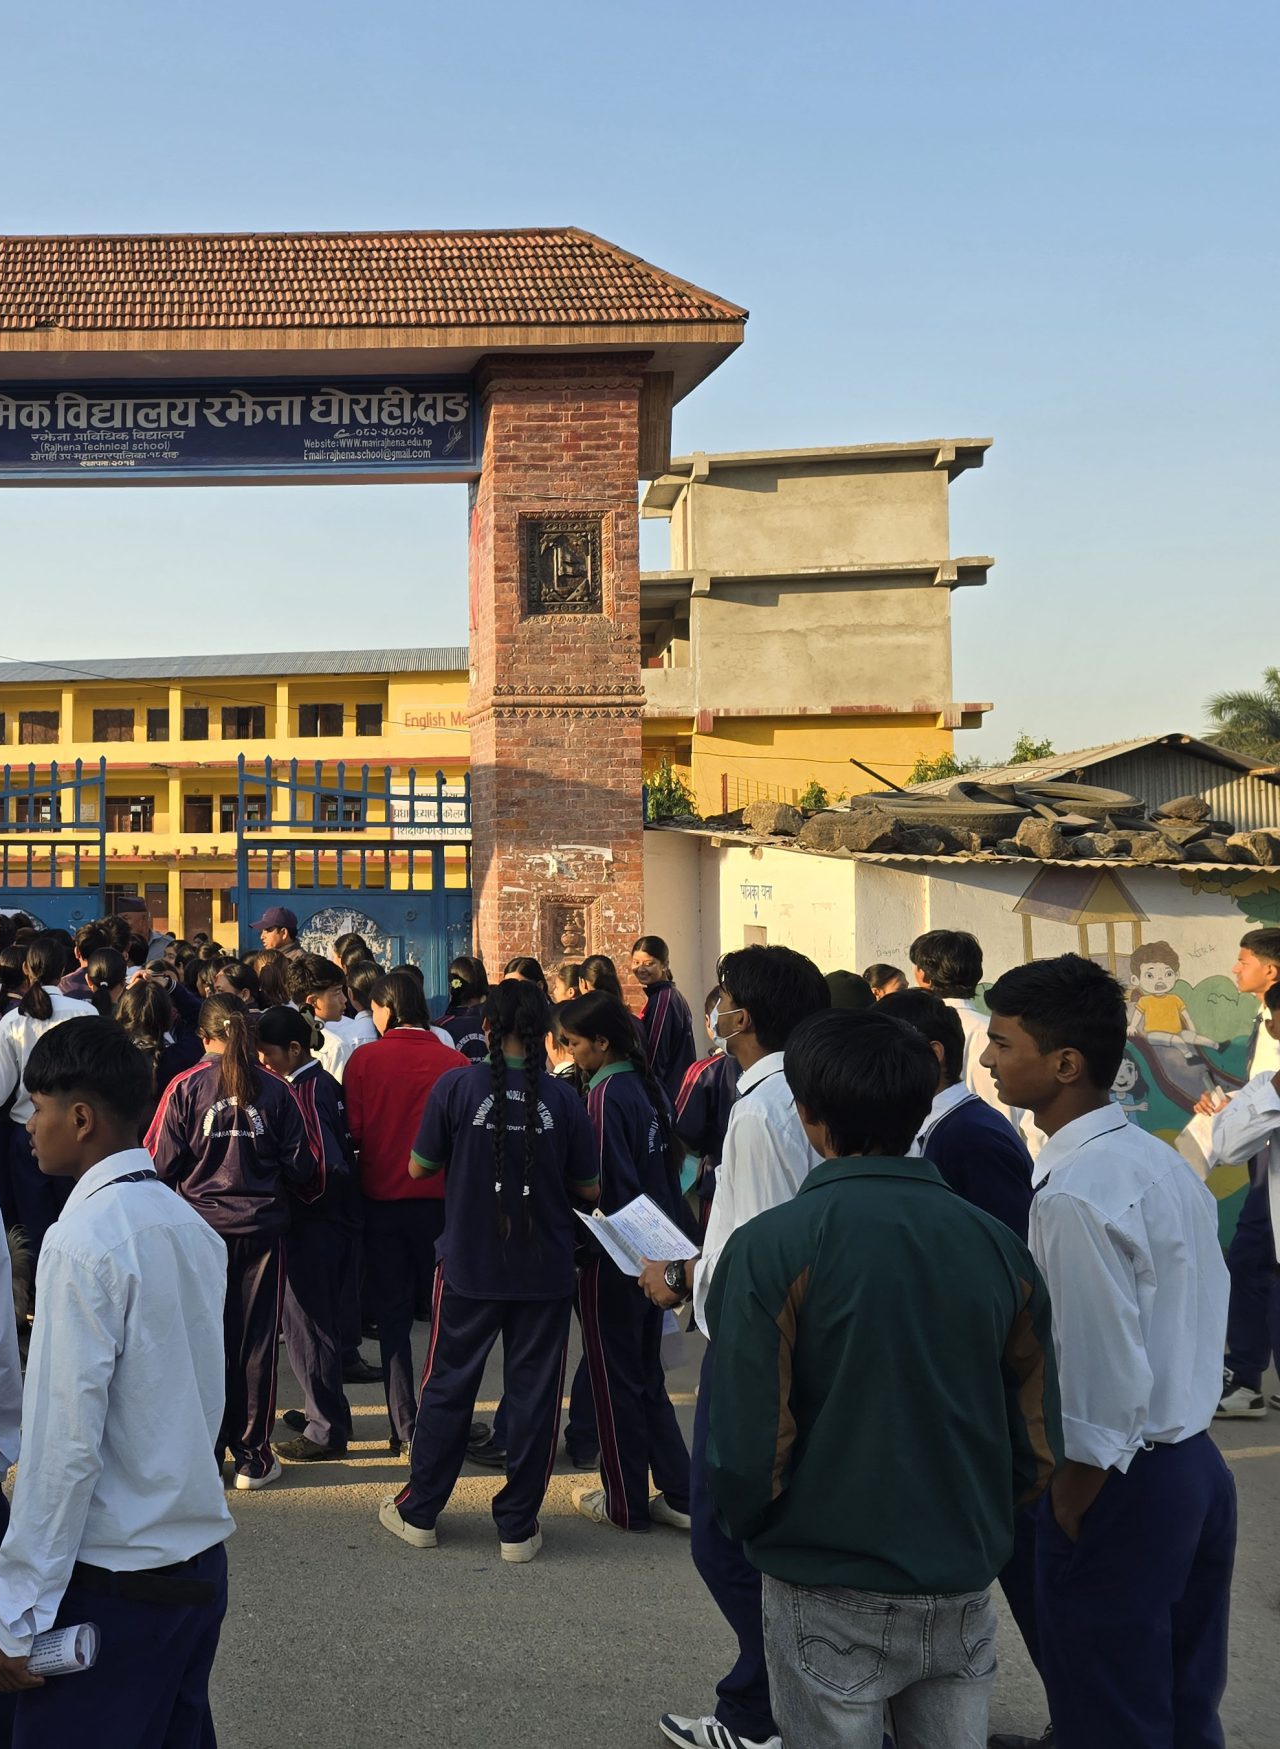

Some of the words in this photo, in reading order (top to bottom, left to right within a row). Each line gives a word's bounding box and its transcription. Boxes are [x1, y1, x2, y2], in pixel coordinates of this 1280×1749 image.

[54, 391, 200, 430] विद्यालय
[132, 429, 185, 440] विद्यालय
[83, 442, 129, 451] Technical
[405, 712, 446, 730] English
[451, 711, 468, 727] Me
